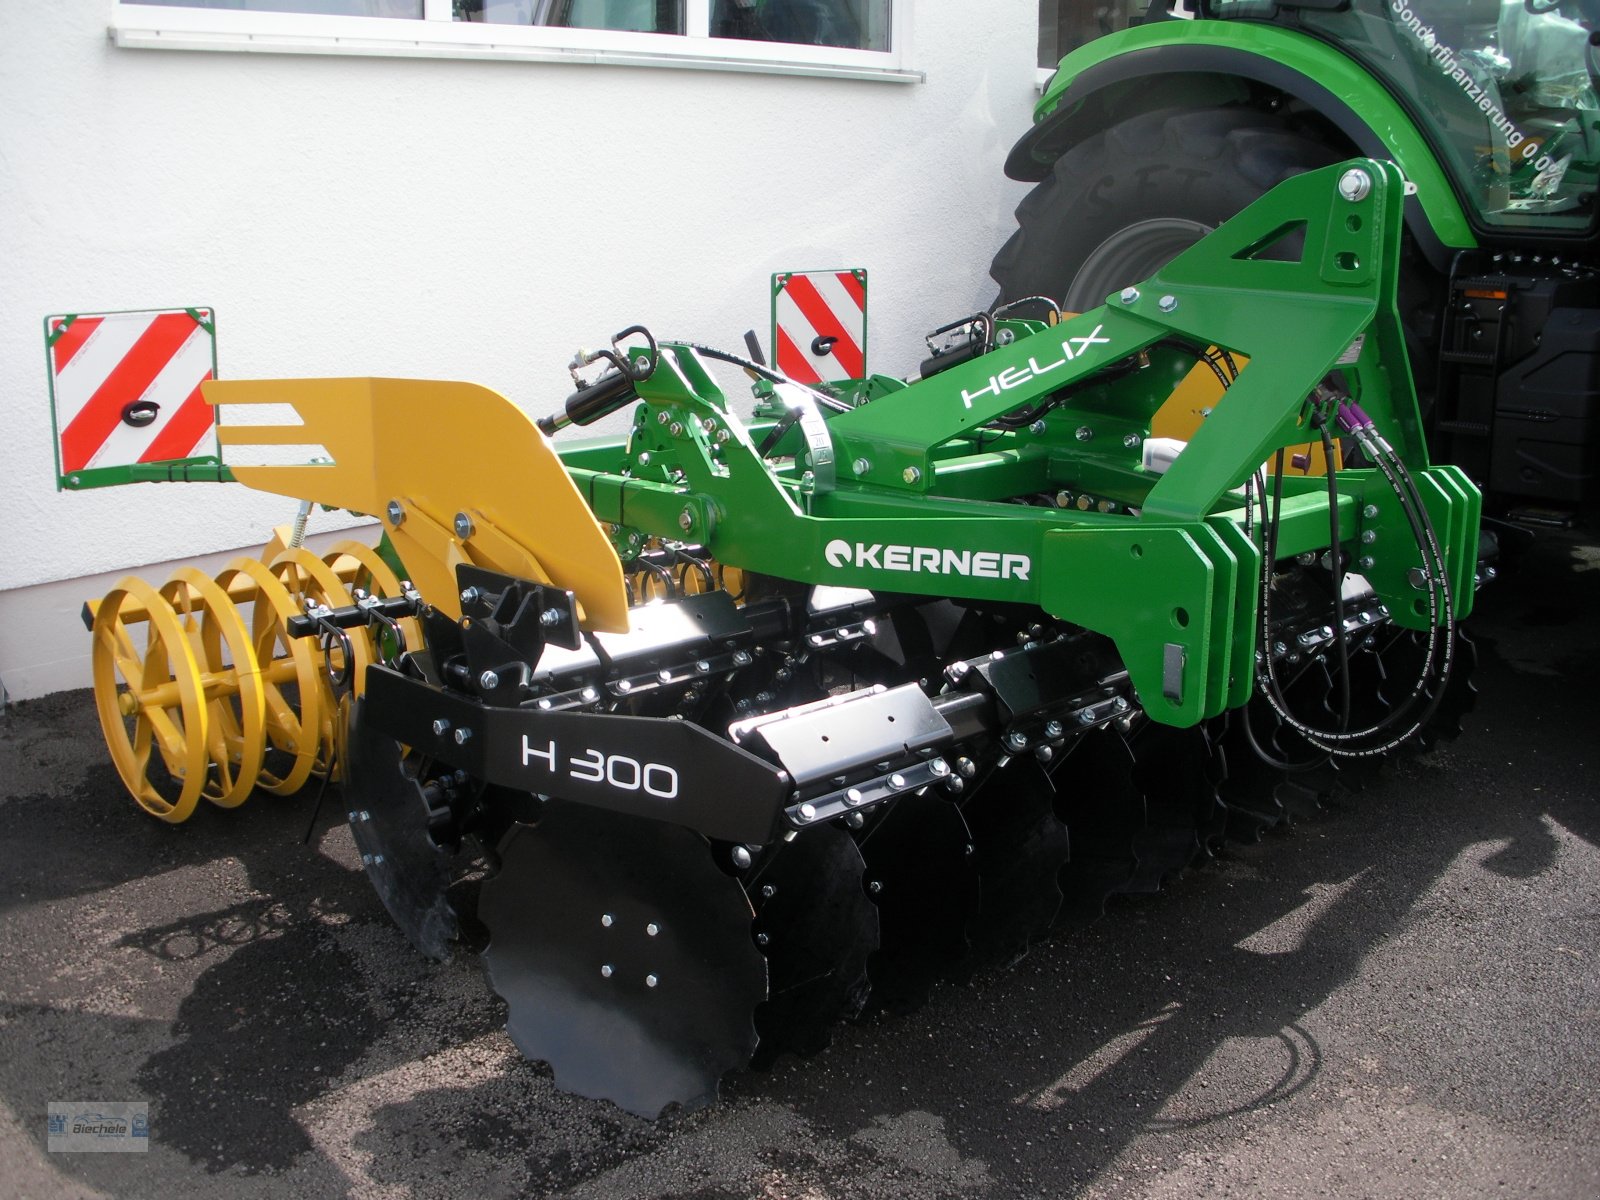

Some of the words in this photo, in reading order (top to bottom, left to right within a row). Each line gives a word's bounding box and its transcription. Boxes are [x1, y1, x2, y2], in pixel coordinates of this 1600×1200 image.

[960, 324, 1110, 409] HELIX
[856, 542, 1031, 581] KERNER
[522, 735, 556, 773] H
[570, 748, 679, 799] 300
